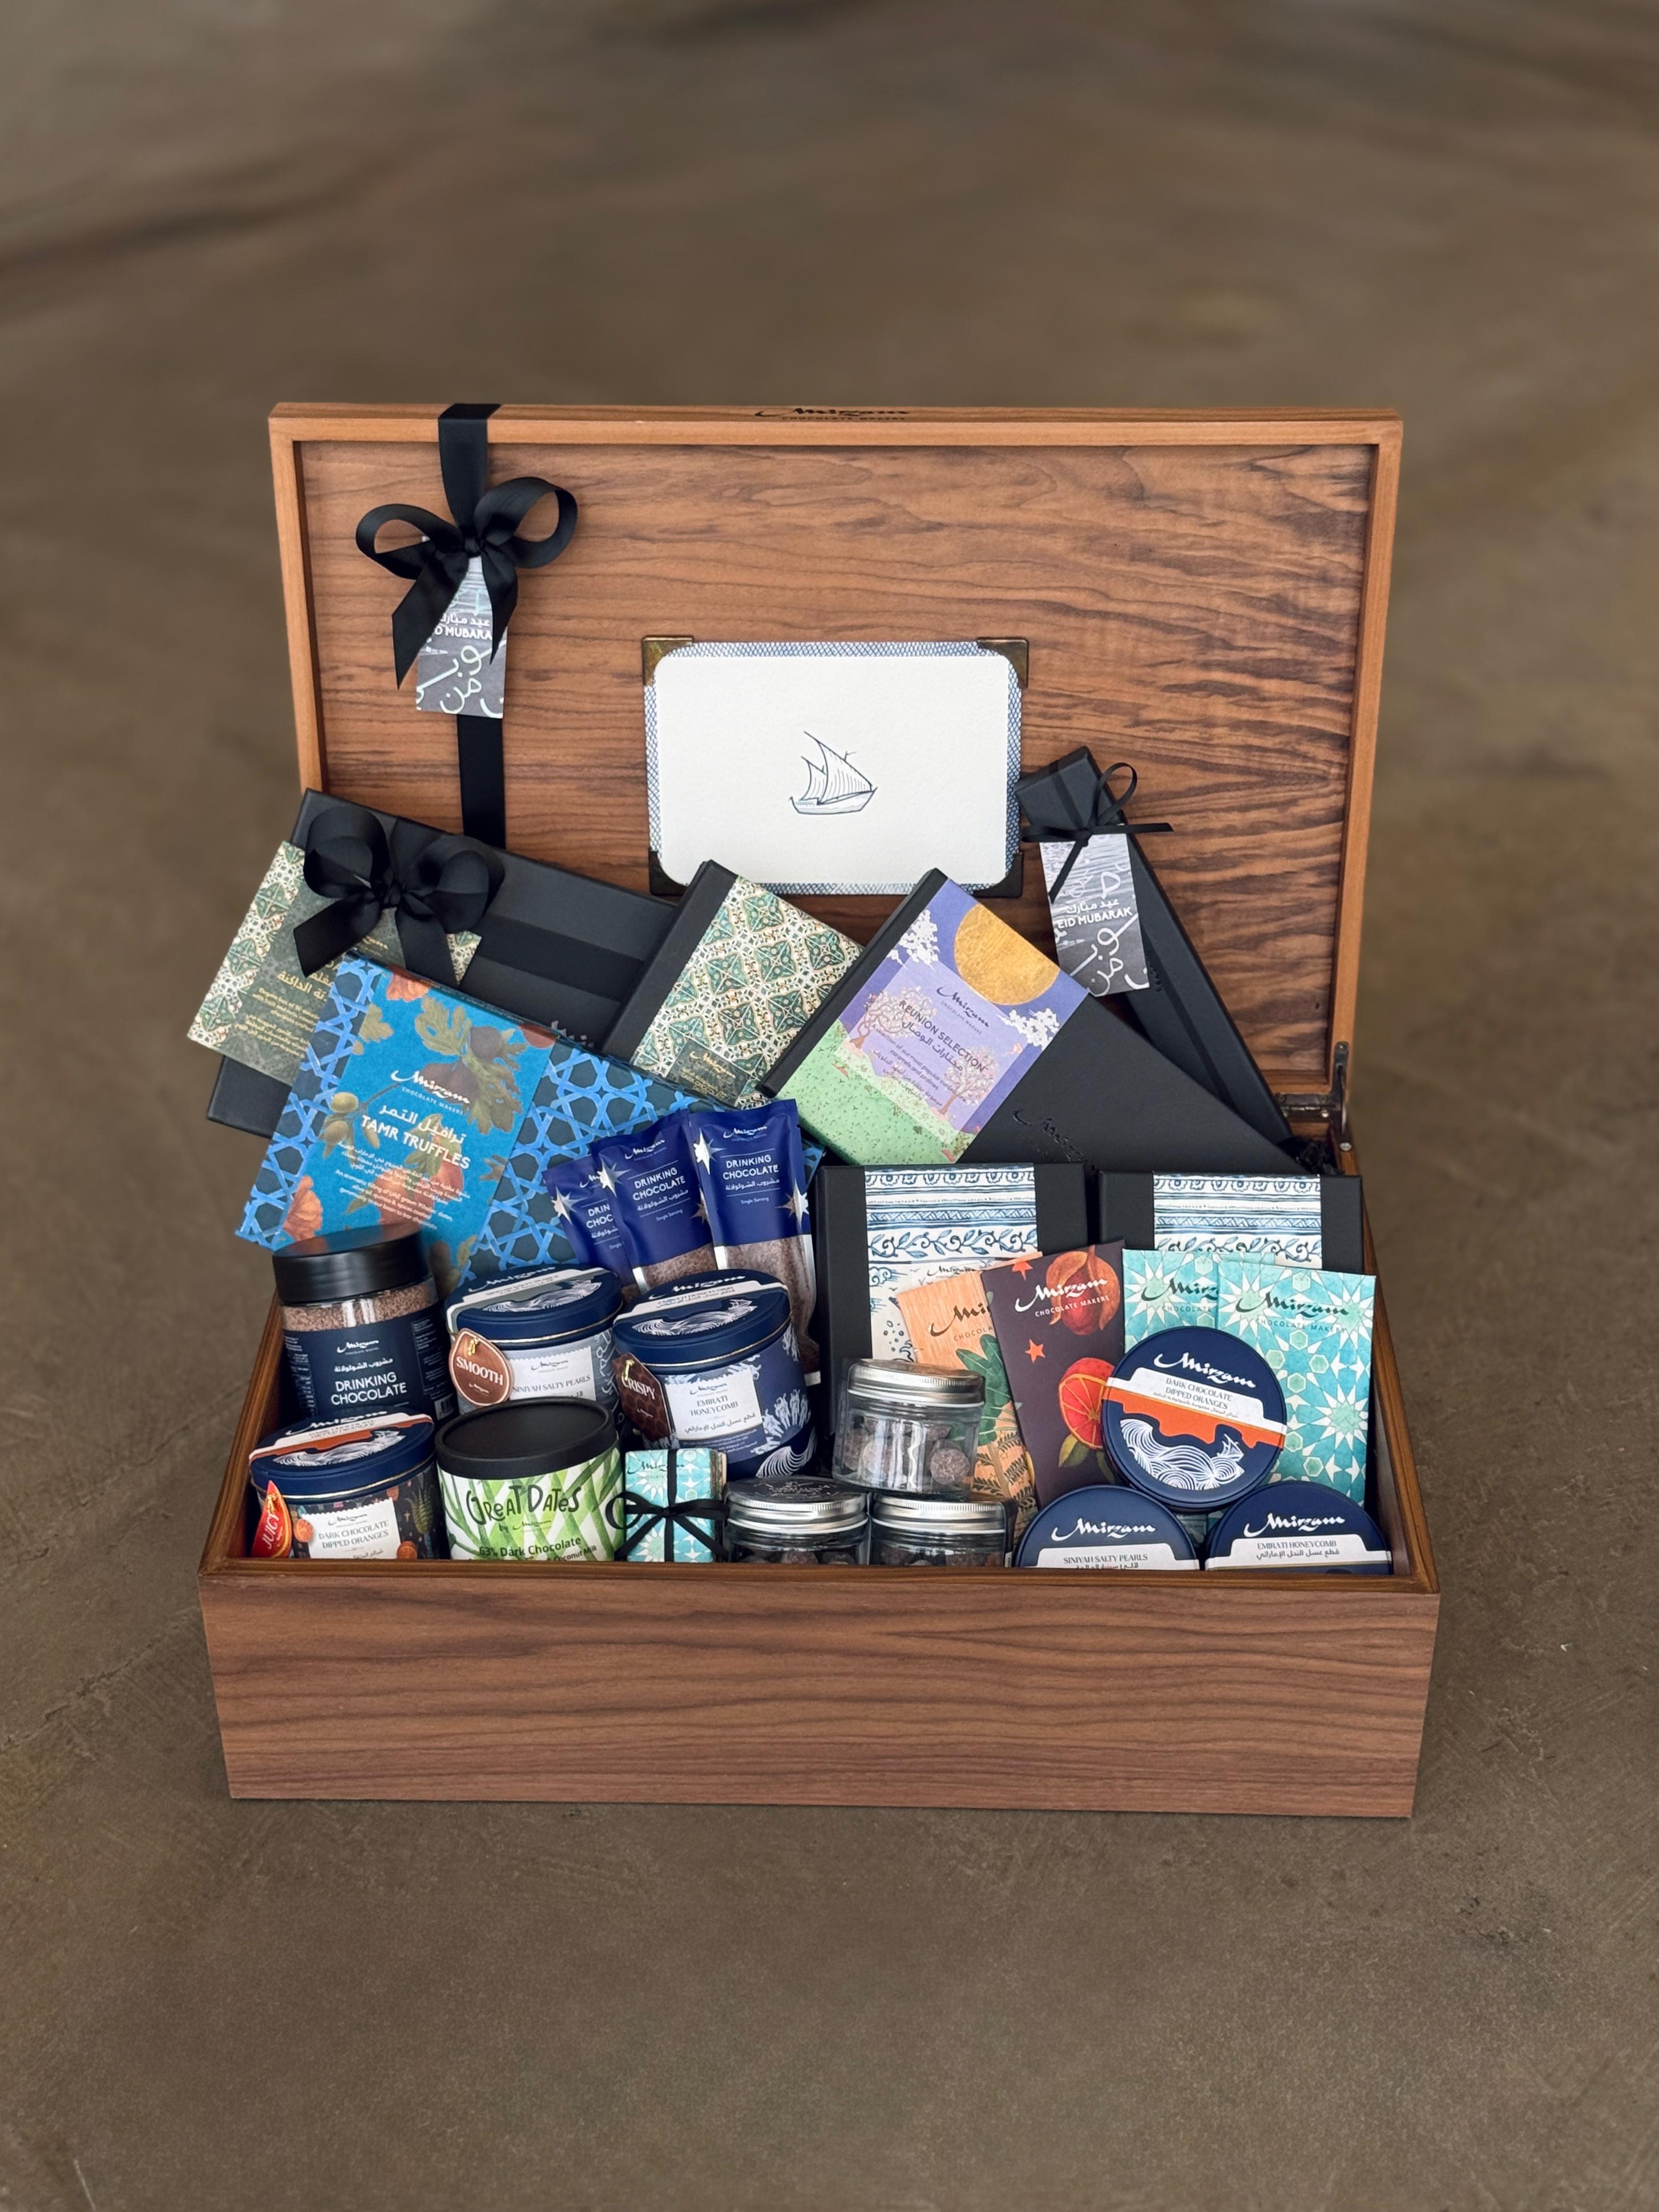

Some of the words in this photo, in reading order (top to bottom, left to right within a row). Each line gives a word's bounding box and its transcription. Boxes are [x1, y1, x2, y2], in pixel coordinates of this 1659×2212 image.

[446, 628, 493, 640] MUBARA
[1057, 917, 1076, 928] EID
[1078, 907, 1133, 925] MUBARAK
[899, 1000, 939, 1035] REUNION
[937, 986, 988, 1028] Mirzam
[933, 1045, 963, 1075] مختارات
[390, 1070, 470, 1104] Mirzam
[402, 1087, 437, 1105] CHOCOLATE
[379, 1105, 418, 1124] التمر
[361, 1115, 399, 1141] TAMR
[403, 1131, 471, 1169] TRUFFLES
[418, 1119, 467, 1144] ترافيل
[722, 1164, 779, 1180] CHOCOLATE
[726, 1155, 772, 1168] DRINKING
[632, 1176, 686, 1200] CHOCOLATE
[634, 1167, 677, 1188] DRINKING
[588, 1204, 611, 1216] DRIN
[1014, 1277, 1108, 1312] Mirzam
[1141, 1278, 1218, 1301] Mirz
[1035, 1302, 1078, 1317] CHOCOLATE
[1080, 1295, 1111, 1307] MAKERS
[1236, 1292, 1349, 1317] Mirzam
[954, 1326, 994, 1342] CHOCOLA
[1256, 1319, 1306, 1330] CHOCOLATE
[337, 1340, 379, 1353] Mirzam
[457, 1356, 503, 1386] SMOOTH
[1153, 1352, 1256, 1388] Mirzam
[335, 1372, 397, 1392] DRINKING
[543, 1381, 564, 1390] SALTY
[566, 1374, 591, 1386] PEARLS
[621, 1373, 655, 1400] CRISPY
[1166, 1377, 1187, 1389] DARK
[1188, 1384, 1233, 1402] CHOCOLATE
[331, 1382, 407, 1405] CHOCOLATE
[697, 1396, 728, 1407] EMIRATI
[1165, 1387, 1192, 1398] DIPPED
[1193, 1395, 1228, 1409] ORANGES
[690, 1401, 738, 1416] HONEYCOMB
[318, 1531, 340, 1539] DARK
[341, 1520, 389, 1537] CHOCOLATE
[499, 1523, 508, 1533] by
[1051, 1518, 1156, 1541] Mirzam
[1244, 1513, 1346, 1538] Mirzam
[322, 1539, 350, 1548] DIPPED
[351, 1530, 389, 1545] ORANGES
[500, 1546, 525, 1557] Dark
[528, 1537, 582, 1554] Chocolate
[1290, 1540, 1337, 1548] HONEYCOMB
[584, 1545, 598, 1555] Milk
[1119, 1554, 1148, 1562] PEARLS
